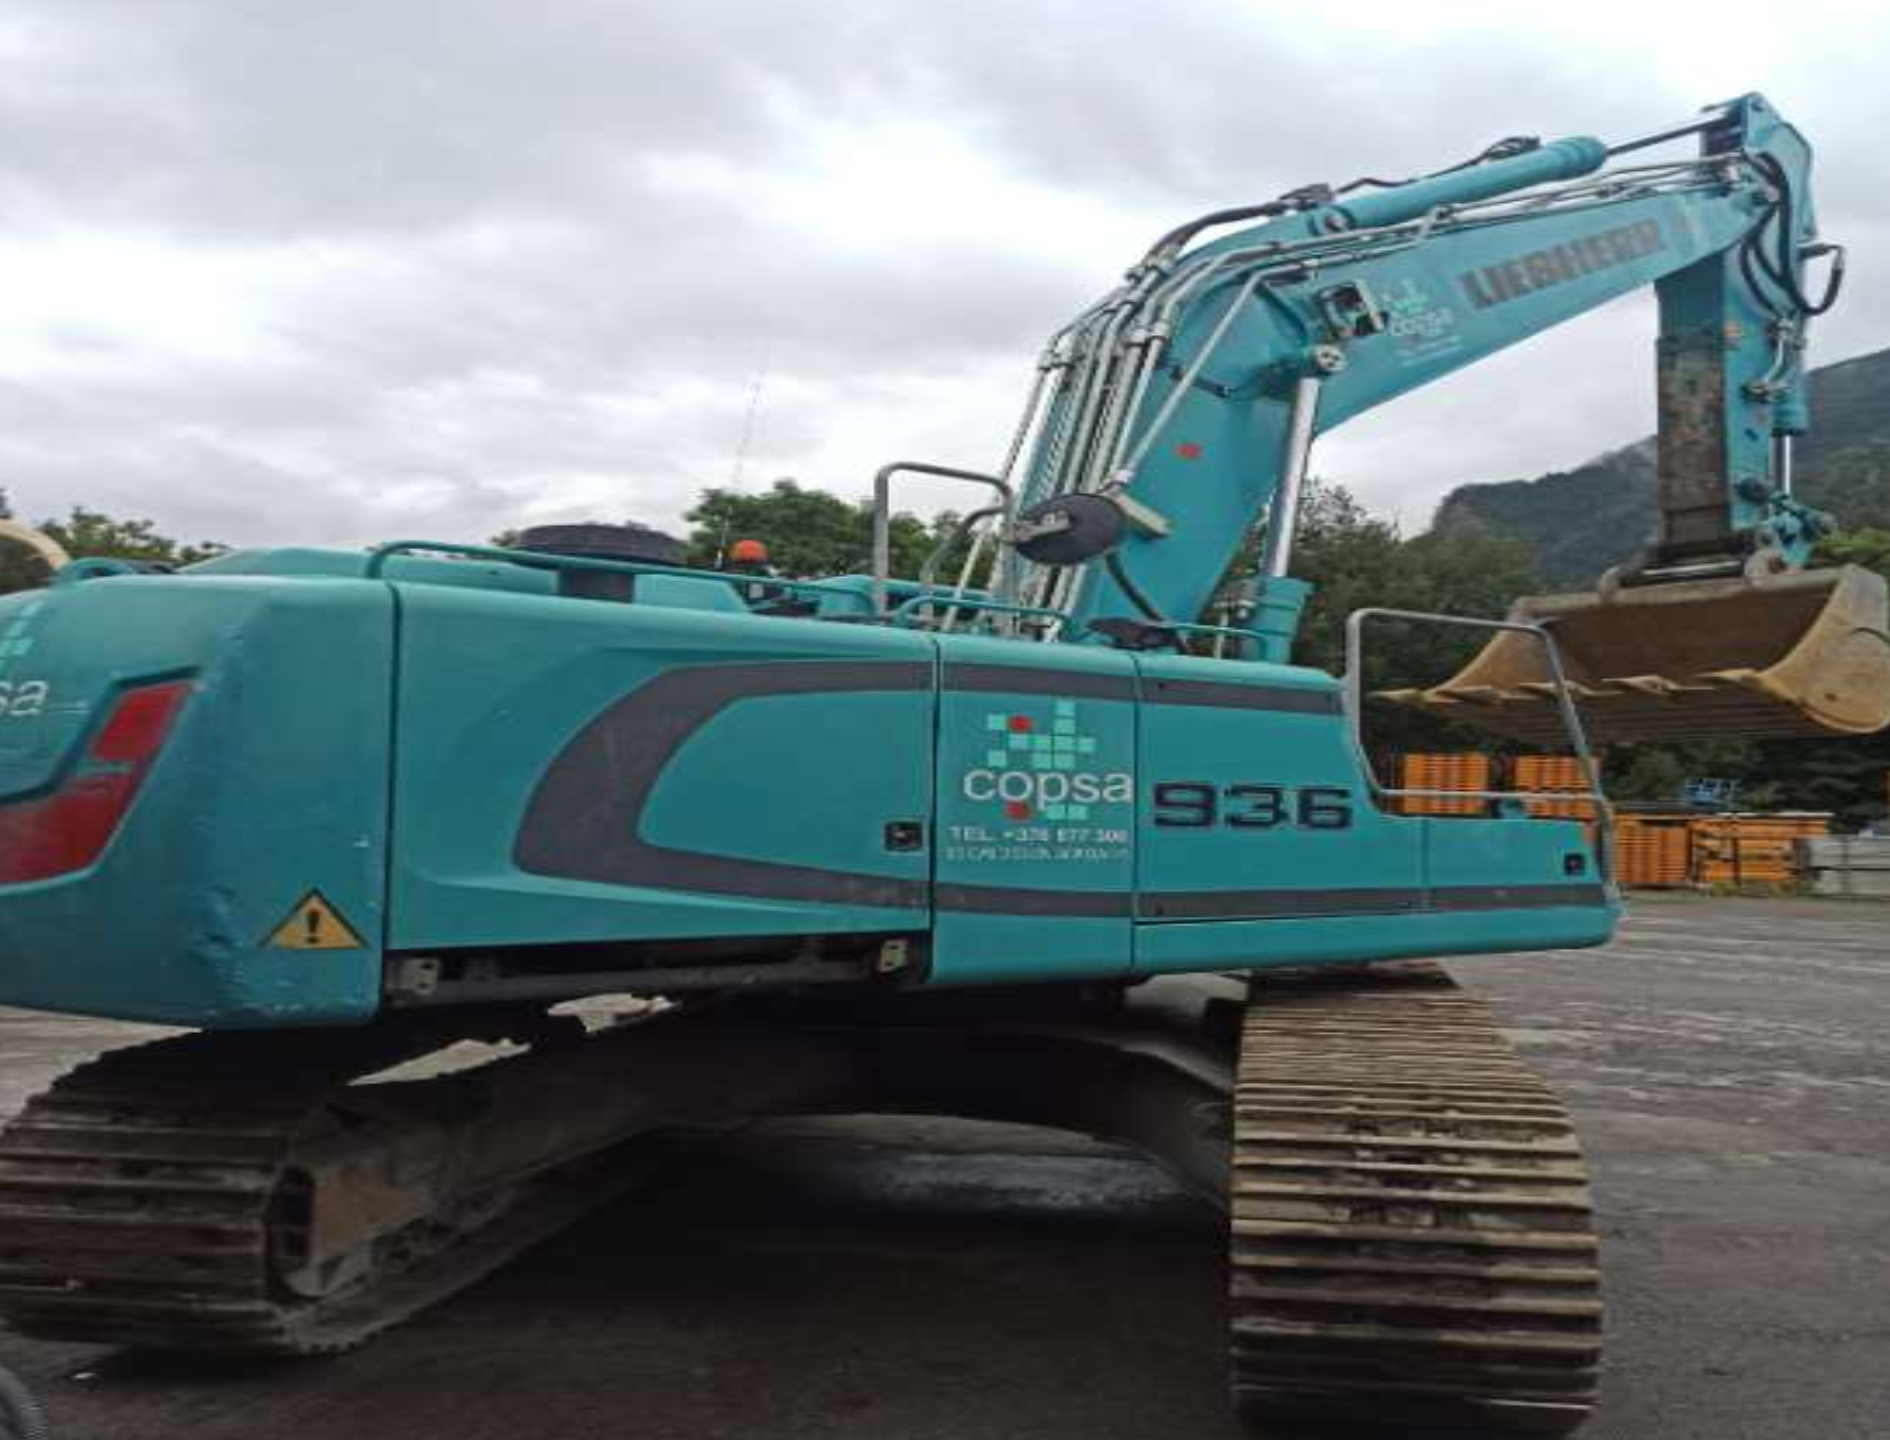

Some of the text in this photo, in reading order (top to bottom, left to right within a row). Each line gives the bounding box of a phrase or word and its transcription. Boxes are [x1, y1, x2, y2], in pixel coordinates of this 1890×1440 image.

[1460, 218, 1667, 308] LIEBHERR
[963, 770, 1134, 811] copsa
[1154, 781, 1352, 829] 936
